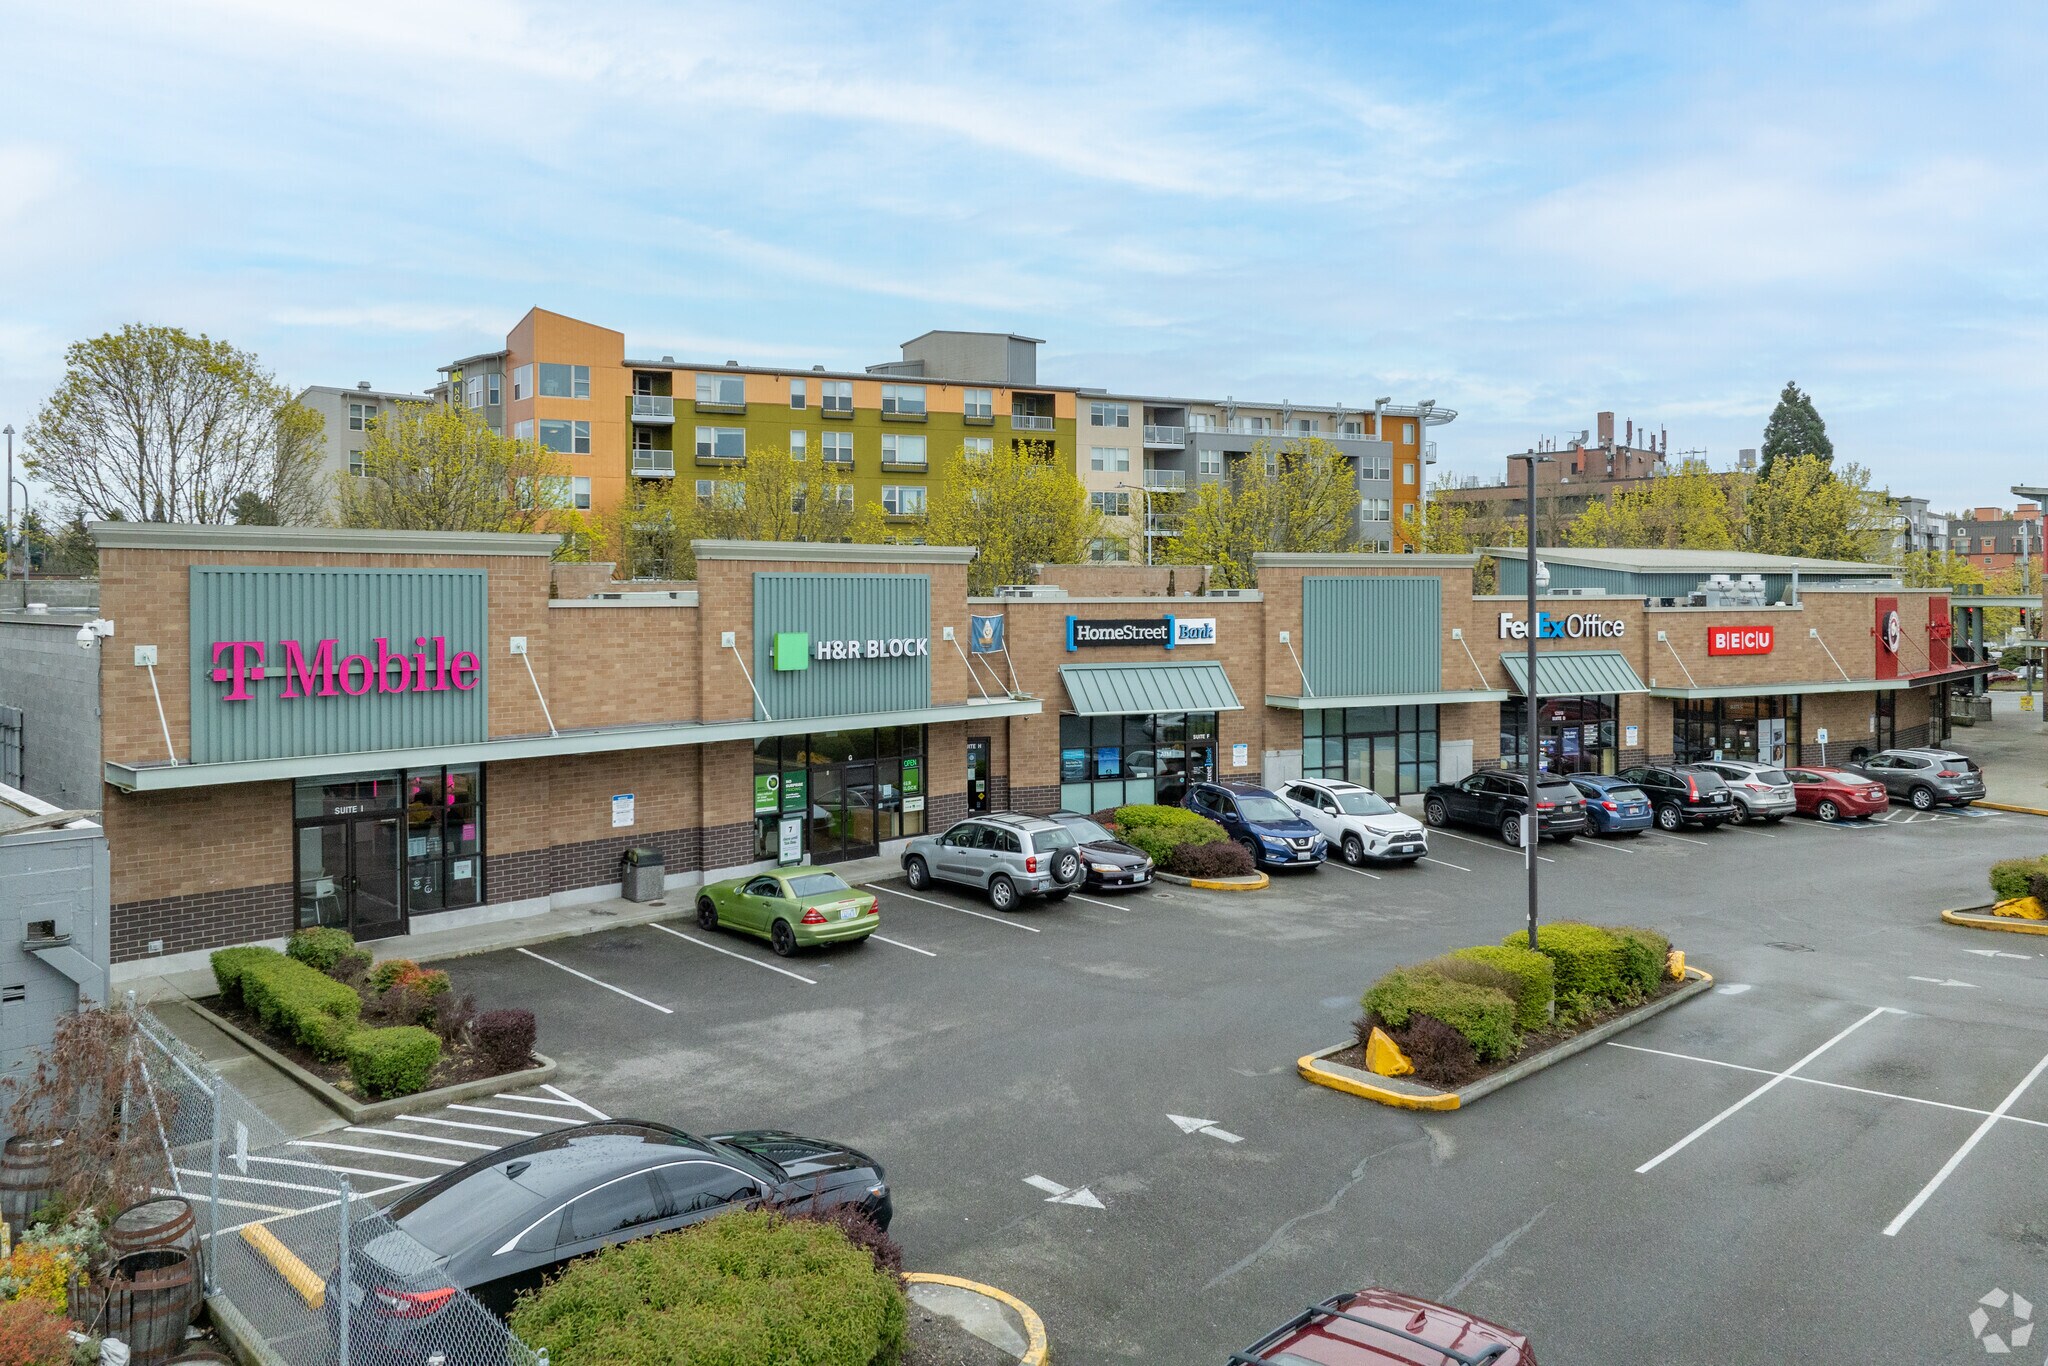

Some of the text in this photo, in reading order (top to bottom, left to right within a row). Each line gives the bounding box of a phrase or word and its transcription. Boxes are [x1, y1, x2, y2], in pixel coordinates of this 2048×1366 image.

[1077, 623, 1213, 640] HomeStreet Bank
[1565, 613, 1625, 638] Office
[815, 638, 928, 660] H&R BLOCK
[903, 759, 917, 767] OPEN
[334, 805, 358, 815] SUITE
